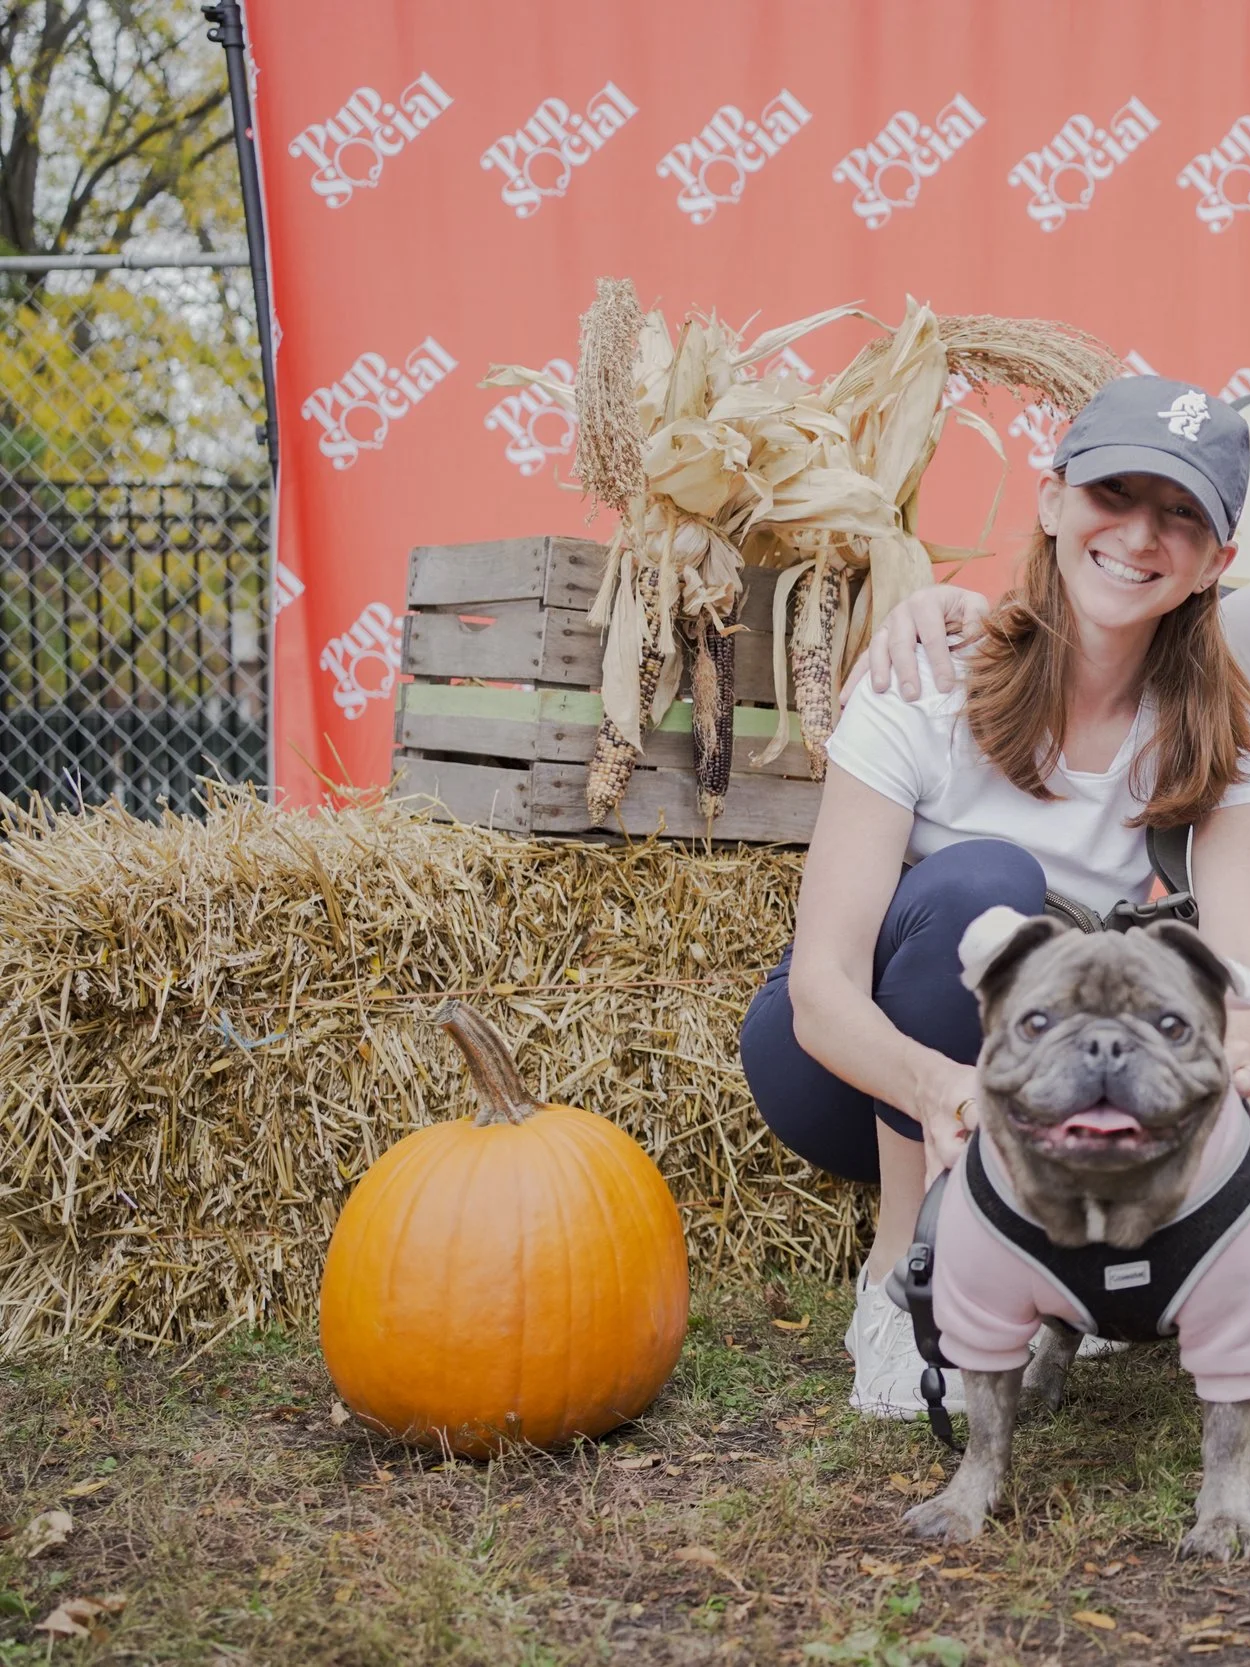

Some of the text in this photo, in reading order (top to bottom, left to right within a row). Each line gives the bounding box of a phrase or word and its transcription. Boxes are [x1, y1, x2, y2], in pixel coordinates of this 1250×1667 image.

[288, 87, 383, 170] Pup
[311, 71, 454, 209] Social
[479, 96, 571, 179] Pup
[500, 79, 639, 219] Social
[655, 104, 745, 186] Pup
[675, 87, 812, 225] Social
[832, 110, 921, 191] Pup
[852, 92, 987, 230] Social
[1007, 113, 1095, 194] Pup
[1026, 95, 1161, 233] Social
[302, 350, 392, 431] Pup
[324, 334, 459, 470] Social
